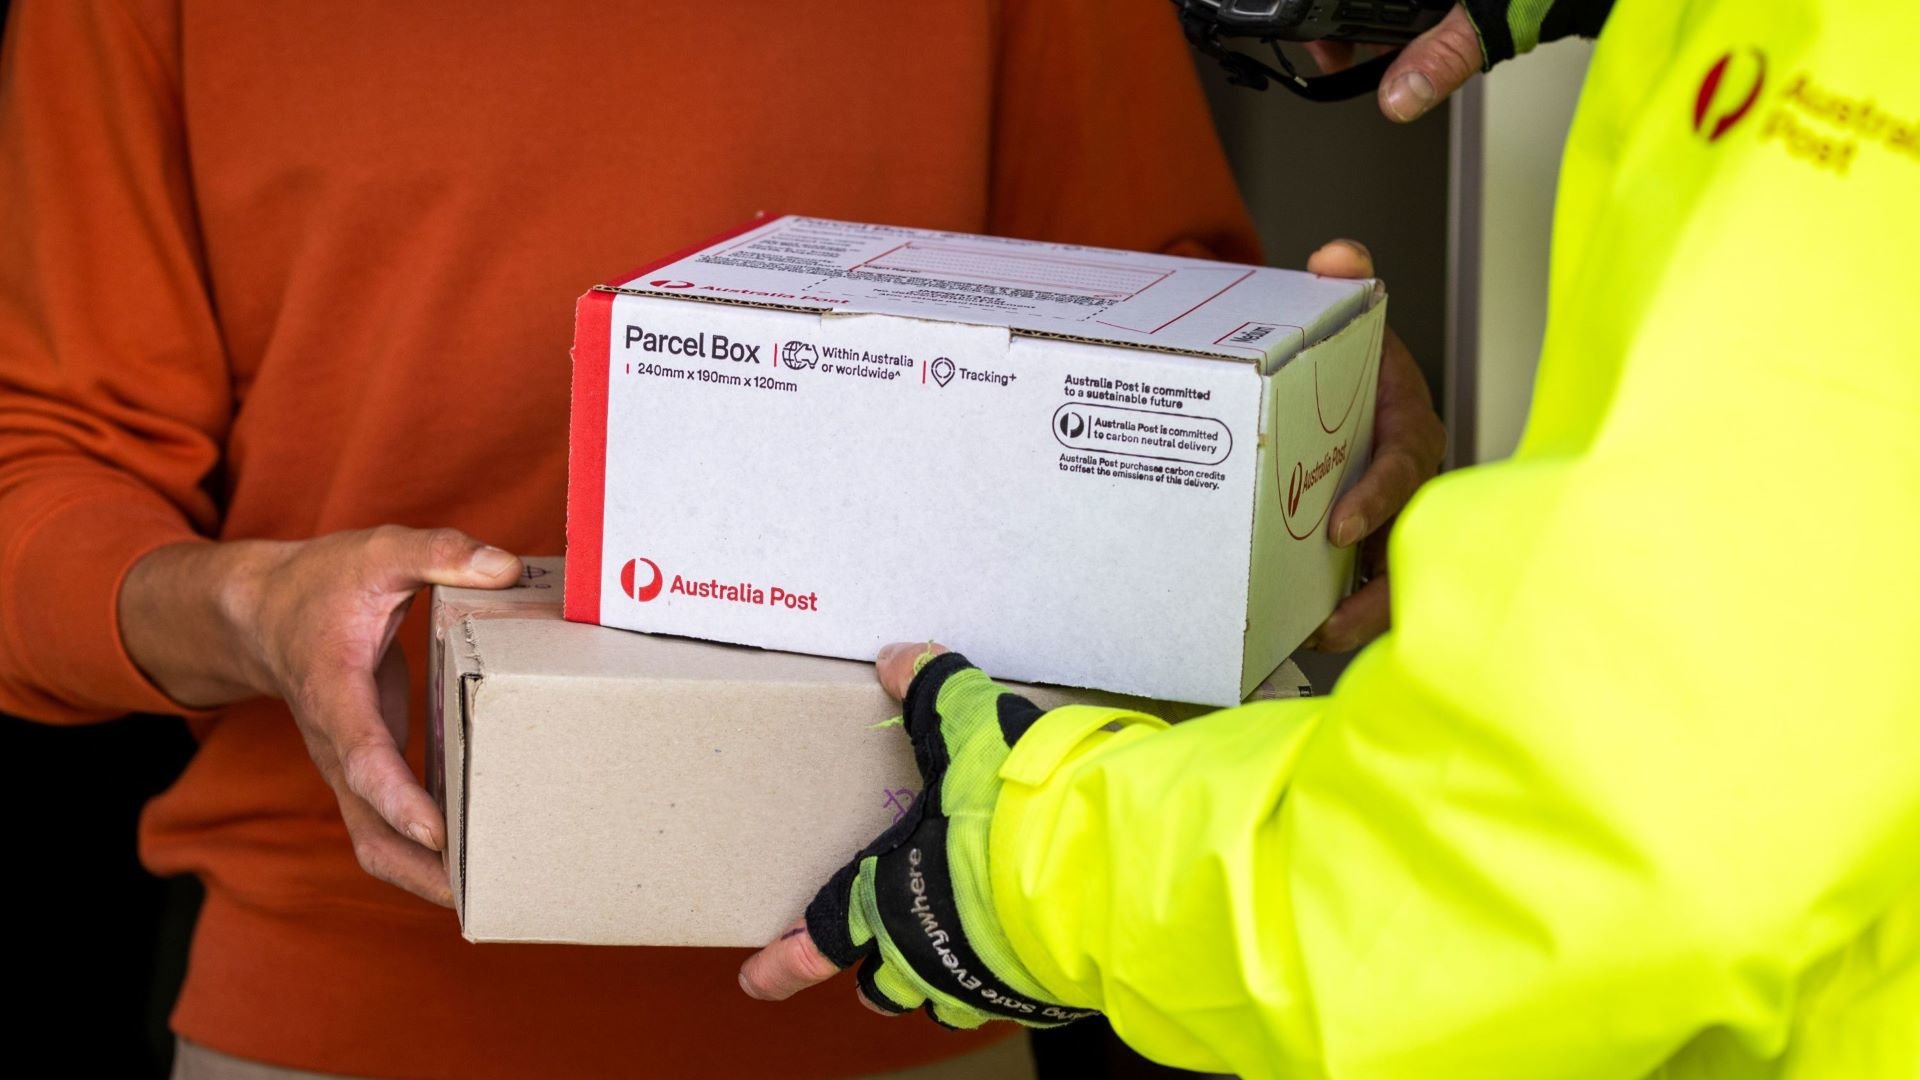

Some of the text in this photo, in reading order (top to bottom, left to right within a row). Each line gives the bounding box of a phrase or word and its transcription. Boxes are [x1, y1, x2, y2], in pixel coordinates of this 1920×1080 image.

[699, 285, 851, 305] Australia Post
[625, 324, 761, 364] Parcel Box
[822, 345, 914, 368] Within Australia
[637, 362, 798, 393] 240mm x 190mm x 120mm
[821, 363, 901, 381] or worldwide^
[958, 367, 1018, 387] Tracking+
[1063, 386, 1184, 410] to a sustainable future
[1064, 374, 1212, 401] Australia Post is committed
[1094, 417, 1219, 442] Australia Post is committed
[1094, 430, 1218, 455] to carbon neutral delivery
[1059, 453, 1226, 482] Australia Post purchases carbon credits
[1059, 462, 1220, 491] to offset the emissions of this delivery.
[1302, 439, 1347, 495] Australia Post
[670, 574, 818, 612] Australia Post
